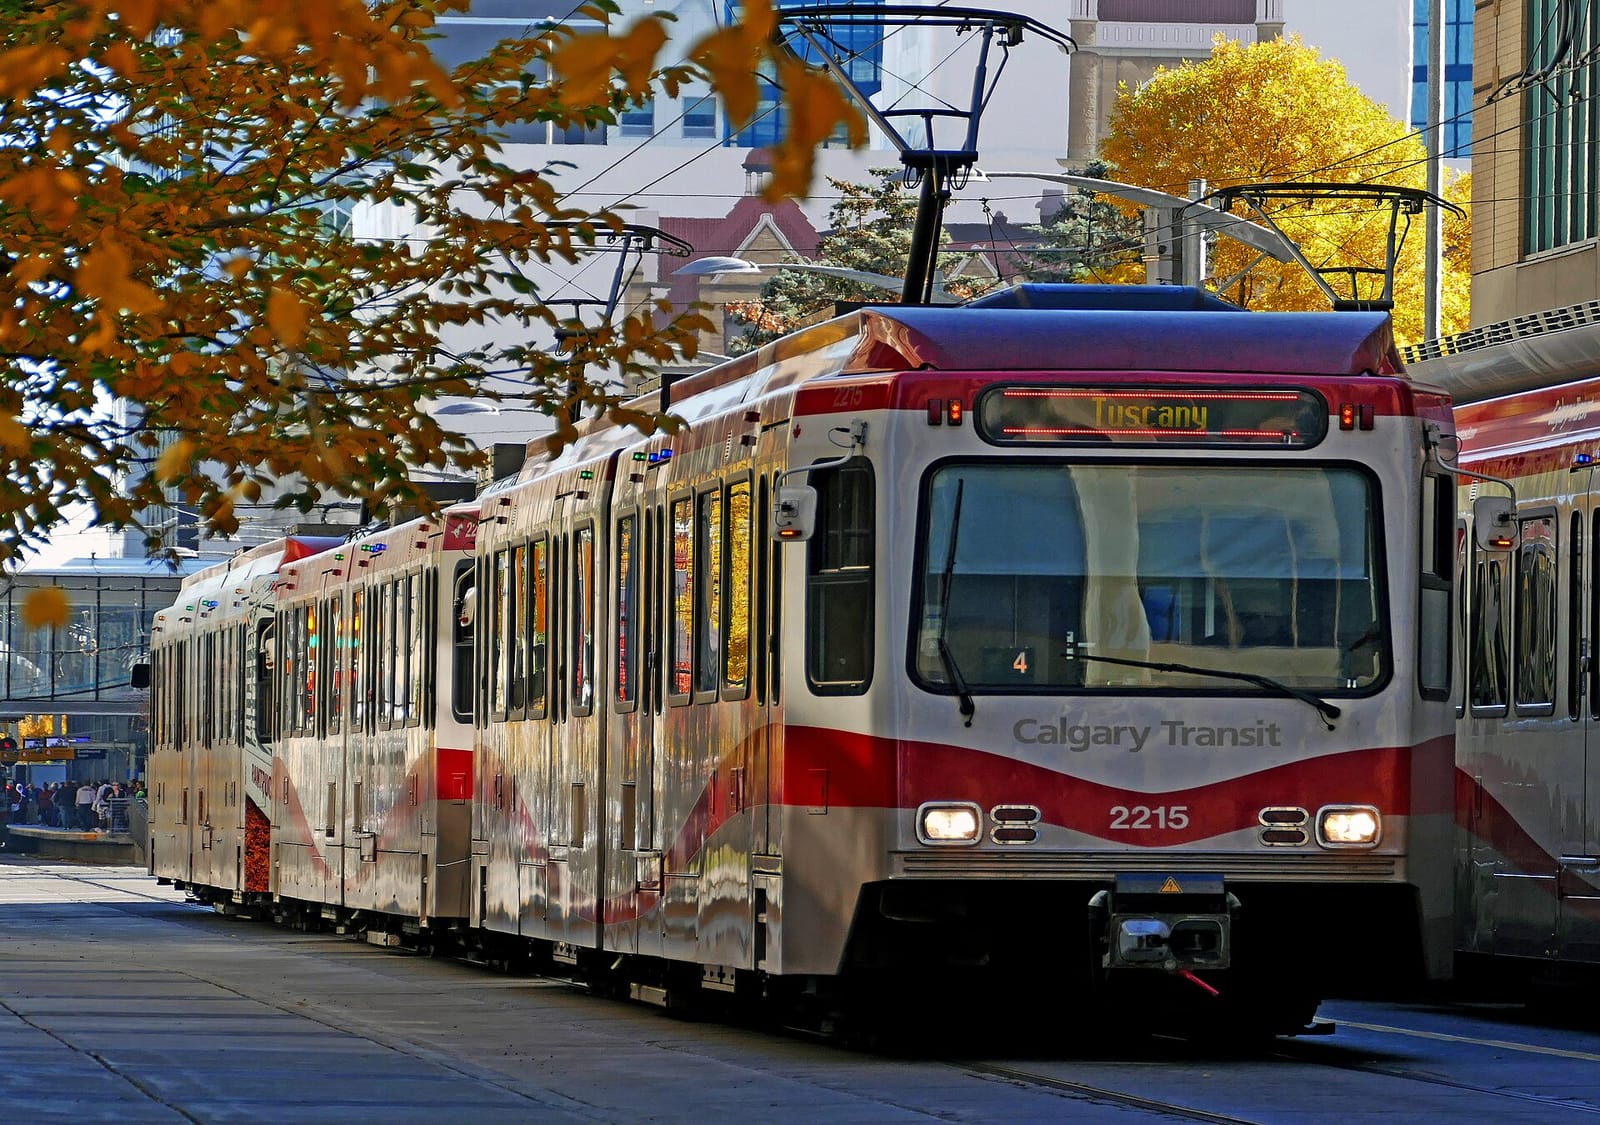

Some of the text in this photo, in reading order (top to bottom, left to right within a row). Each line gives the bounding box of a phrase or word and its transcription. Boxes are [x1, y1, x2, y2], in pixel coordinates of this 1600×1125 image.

[833, 386, 863, 407] 2215
[1092, 396, 1208, 430] Tuscany
[1012, 651, 1028, 674] 4
[1012, 717, 1281, 753] Calgary Transit
[1109, 806, 1189, 830] 2215
